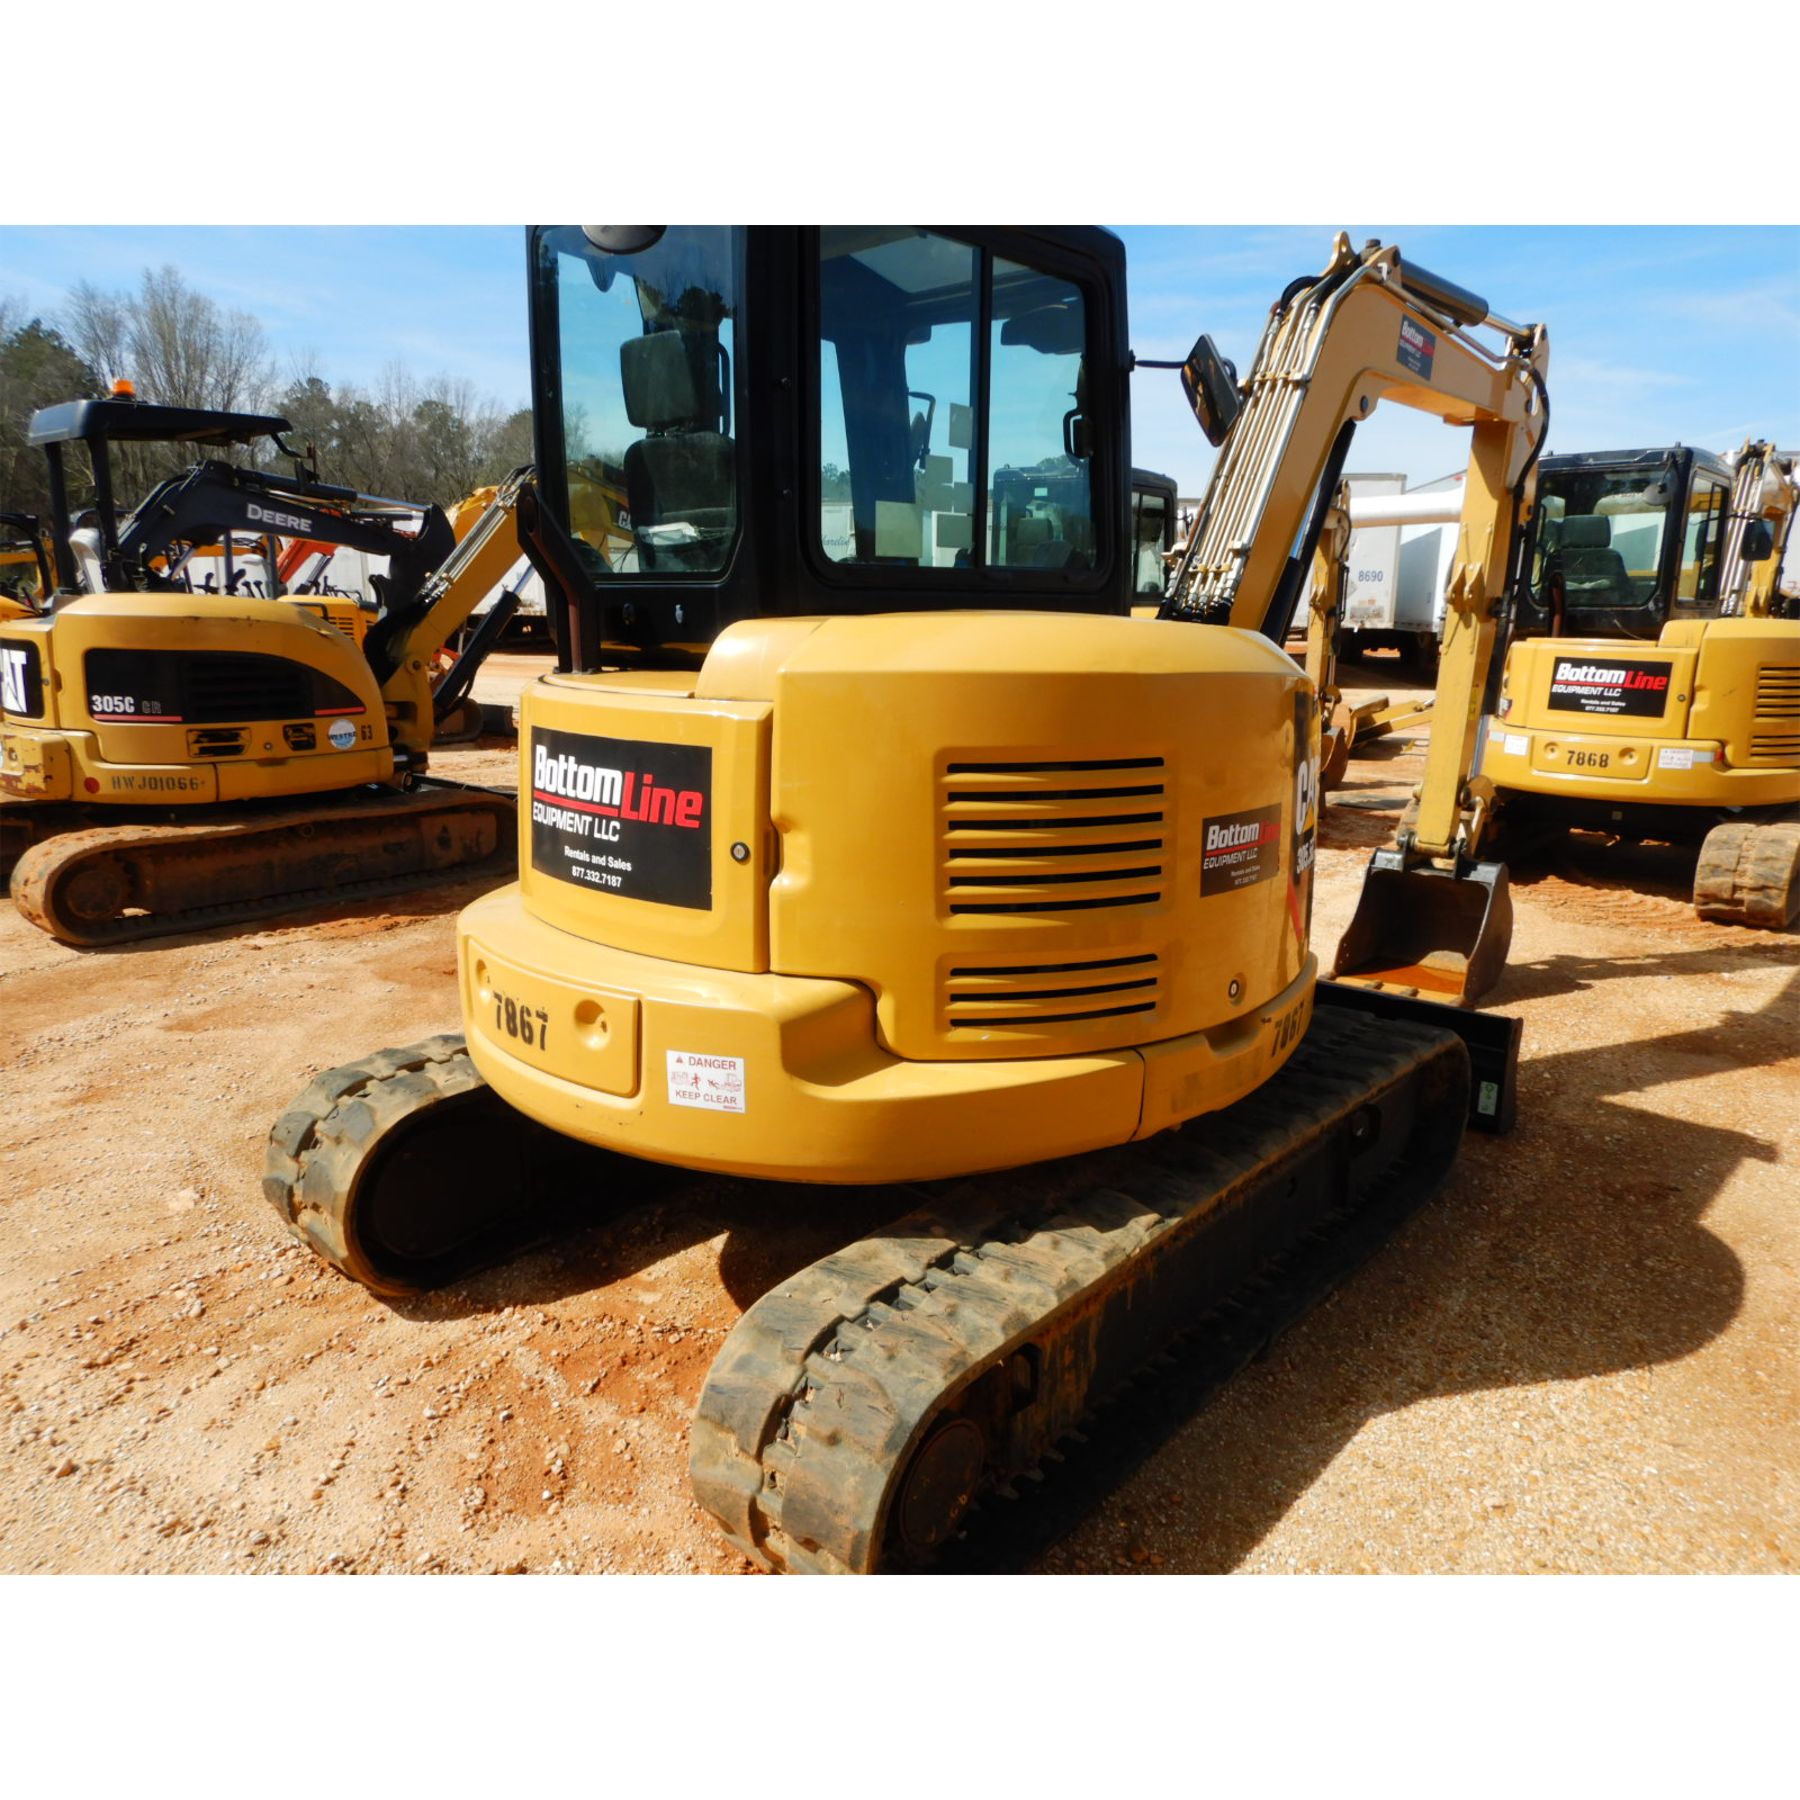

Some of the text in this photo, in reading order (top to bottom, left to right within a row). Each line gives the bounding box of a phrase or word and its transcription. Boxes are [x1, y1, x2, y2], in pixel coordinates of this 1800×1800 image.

[246, 502, 313, 532] DEERE
[1358, 569, 1384, 583] 8690
[1551, 684, 1622, 697] EQUIPMENT LLC
[91, 695, 135, 714] 305C
[1566, 750, 1610, 769] 7868
[532, 801, 621, 842] EQUIPMENT LLC
[563, 845, 633, 872] Rentals and Sales
[1203, 847, 1259, 870] EQUIPMENT LLC
[571, 865, 623, 888] 877.332.7187
[492, 990, 549, 1052] 7867
[688, 1055, 737, 1071] DANGER
[675, 1089, 737, 1105] KEEP CLEAR
